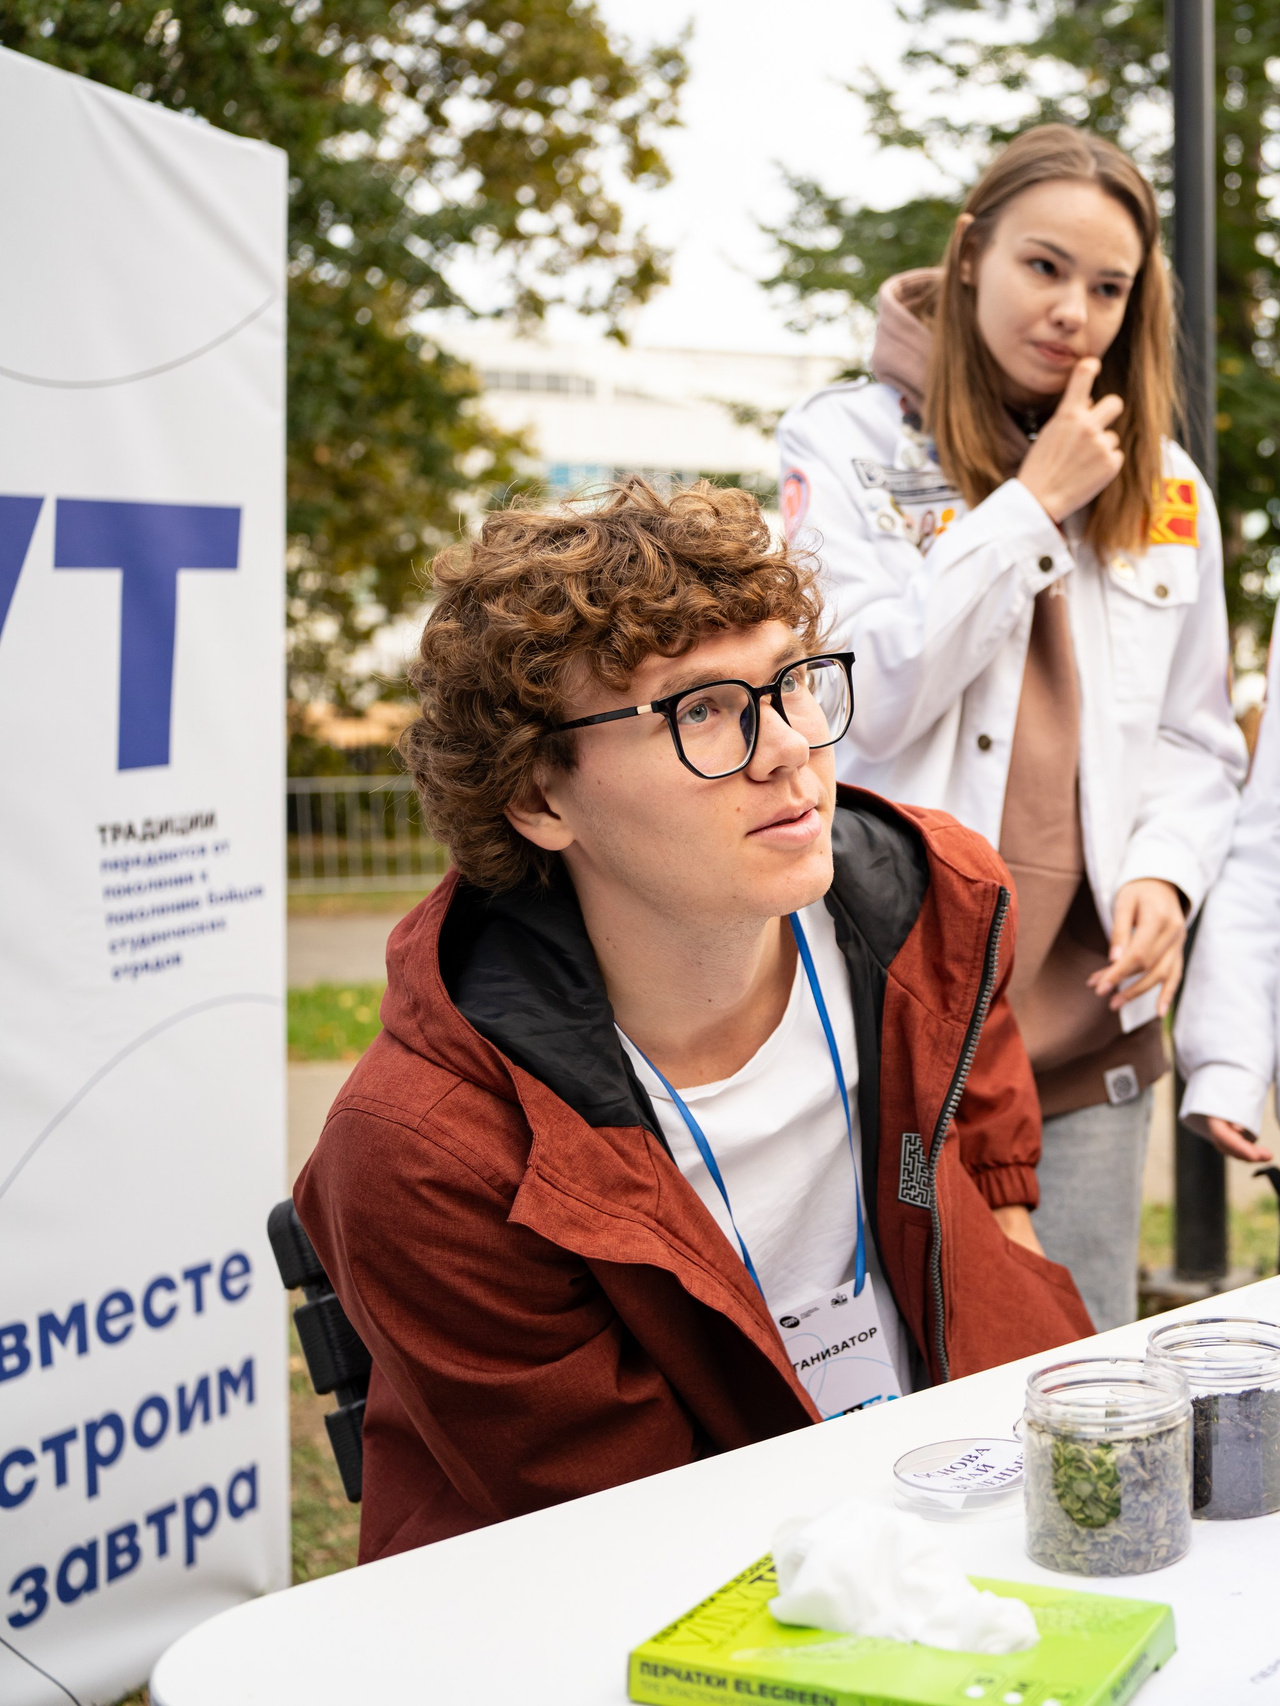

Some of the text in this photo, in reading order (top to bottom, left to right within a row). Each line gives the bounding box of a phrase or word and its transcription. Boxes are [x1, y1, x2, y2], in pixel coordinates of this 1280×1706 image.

[97, 812, 216, 844] ТРАДИЦИИ
[0, 1249, 251, 1384] вместе
[792, 1327, 877, 1373] ГАНИЗАТОР
[0, 1355, 256, 1509] строим
[7, 1462, 259, 1629] завтра
[640, 1661, 727, 1689] ПЕРЧАТКИ
